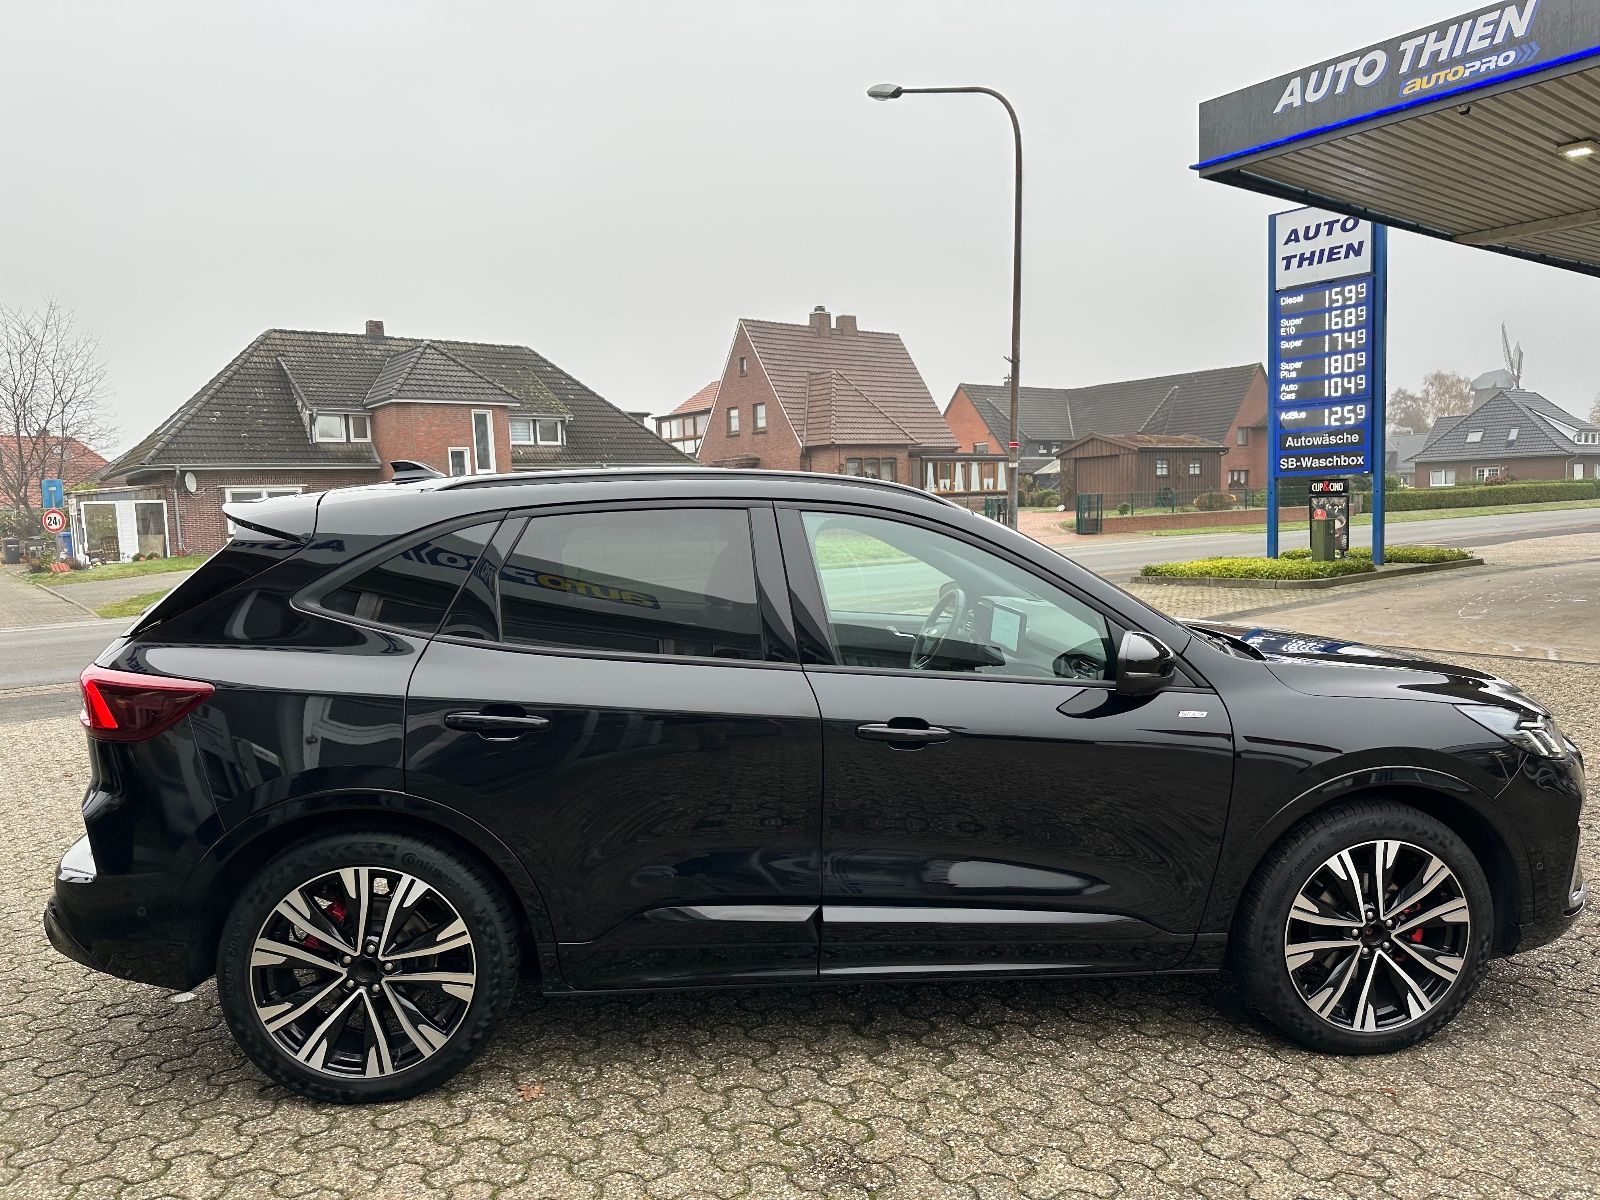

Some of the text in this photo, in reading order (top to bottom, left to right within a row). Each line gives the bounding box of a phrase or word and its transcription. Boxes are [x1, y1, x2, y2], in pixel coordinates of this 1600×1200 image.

[1273, 0, 1540, 114] AUTO THIEN
[1282, 216, 1360, 246] AUTO
[1281, 240, 1365, 271] THIEN
[1280, 294, 1304, 306] Diesel
[1280, 317, 1304, 328] Super
[1280, 326, 1296, 336] E10
[1280, 340, 1303, 350] Super
[1280, 361, 1303, 371] Super
[1280, 370, 1297, 379] Plus
[1280, 384, 1298, 392] Auto
[1280, 393, 1296, 401] Gas
[1280, 411, 1307, 420] AdBlue
[1285, 432, 1360, 448] Autowäsche
[1279, 455, 1365, 469] SB-Waschbox
